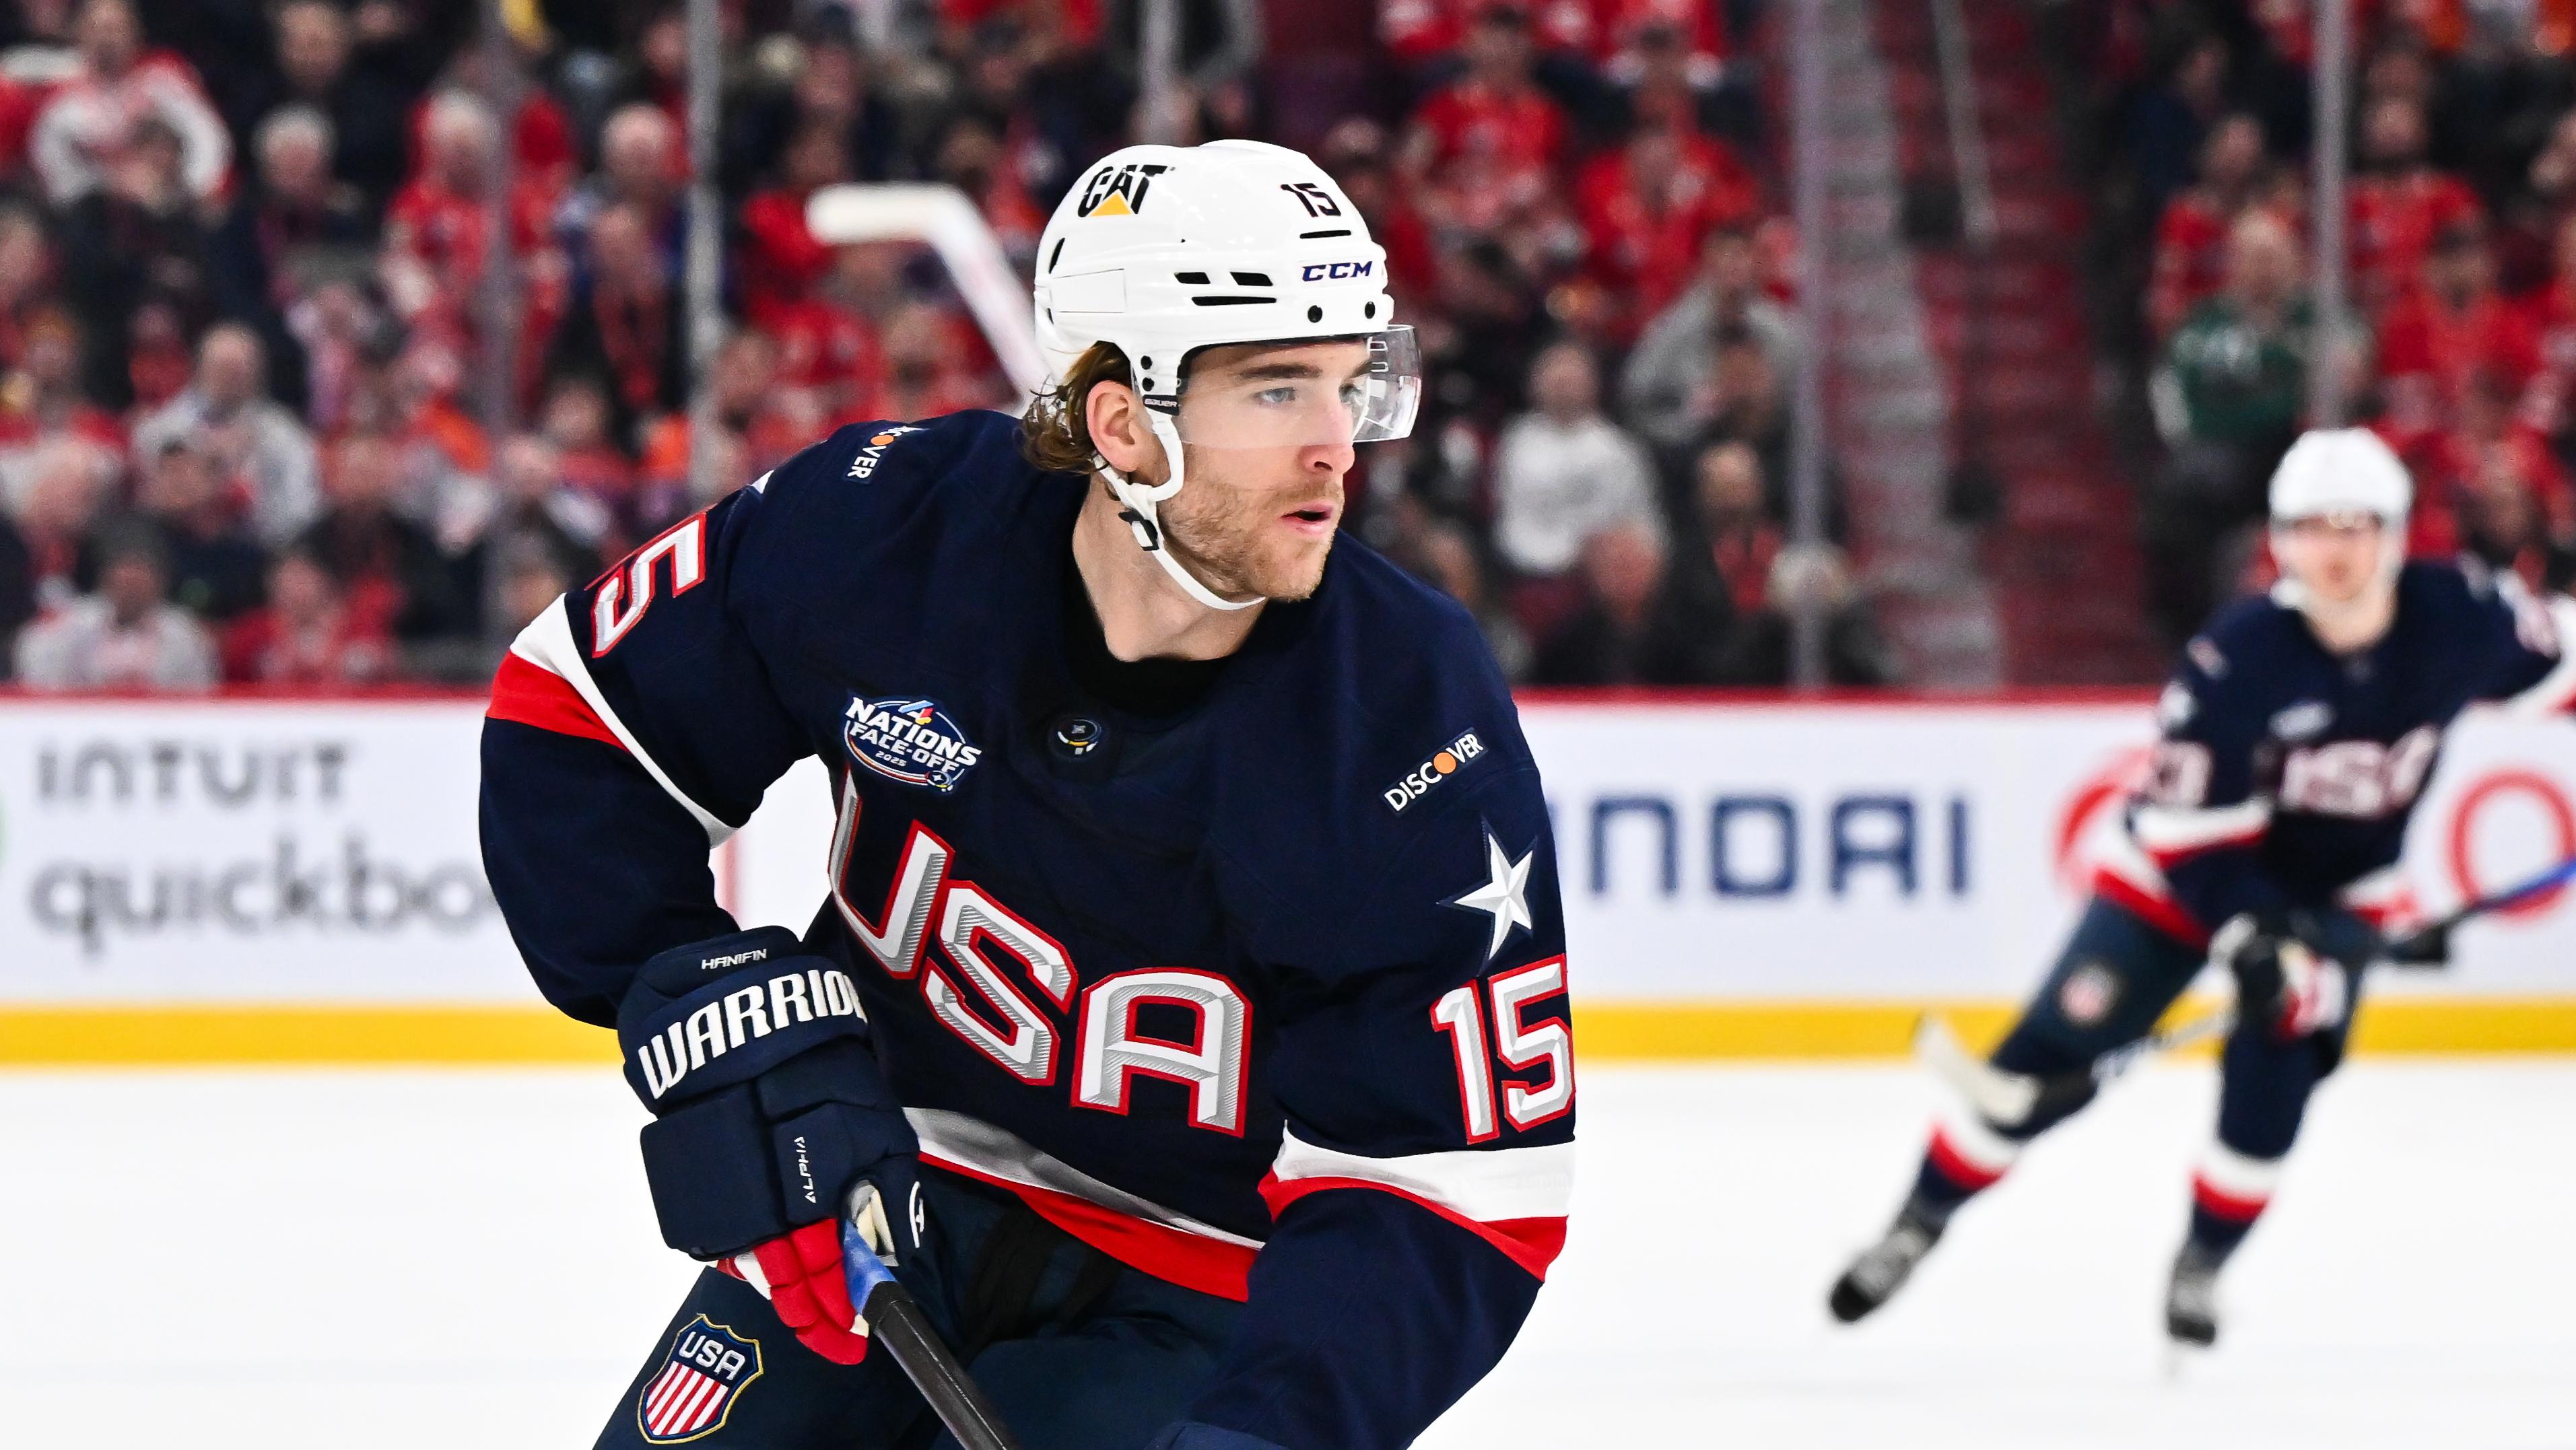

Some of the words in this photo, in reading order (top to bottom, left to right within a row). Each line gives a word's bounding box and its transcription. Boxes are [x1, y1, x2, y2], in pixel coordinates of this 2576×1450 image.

[1078, 164, 1168, 217] CAT
[1281, 182, 1341, 217] 15
[1302, 261, 1373, 282] CCM
[845, 697, 982, 766] NATIONS
[849, 721, 959, 773] FACE-OFF
[875, 751, 908, 767] 2025
[1384, 733, 1484, 812] DISCOVER
[1550, 793, 1969, 898] NDAI
[28, 831, 498, 957] quickbo
[701, 948, 767, 970] HANIFIN
[827, 762, 1253, 1138] USA
[1429, 953, 1576, 1145] 15
[794, 1136, 817, 1204] ALPHA
[679, 1331, 746, 1380] USA
